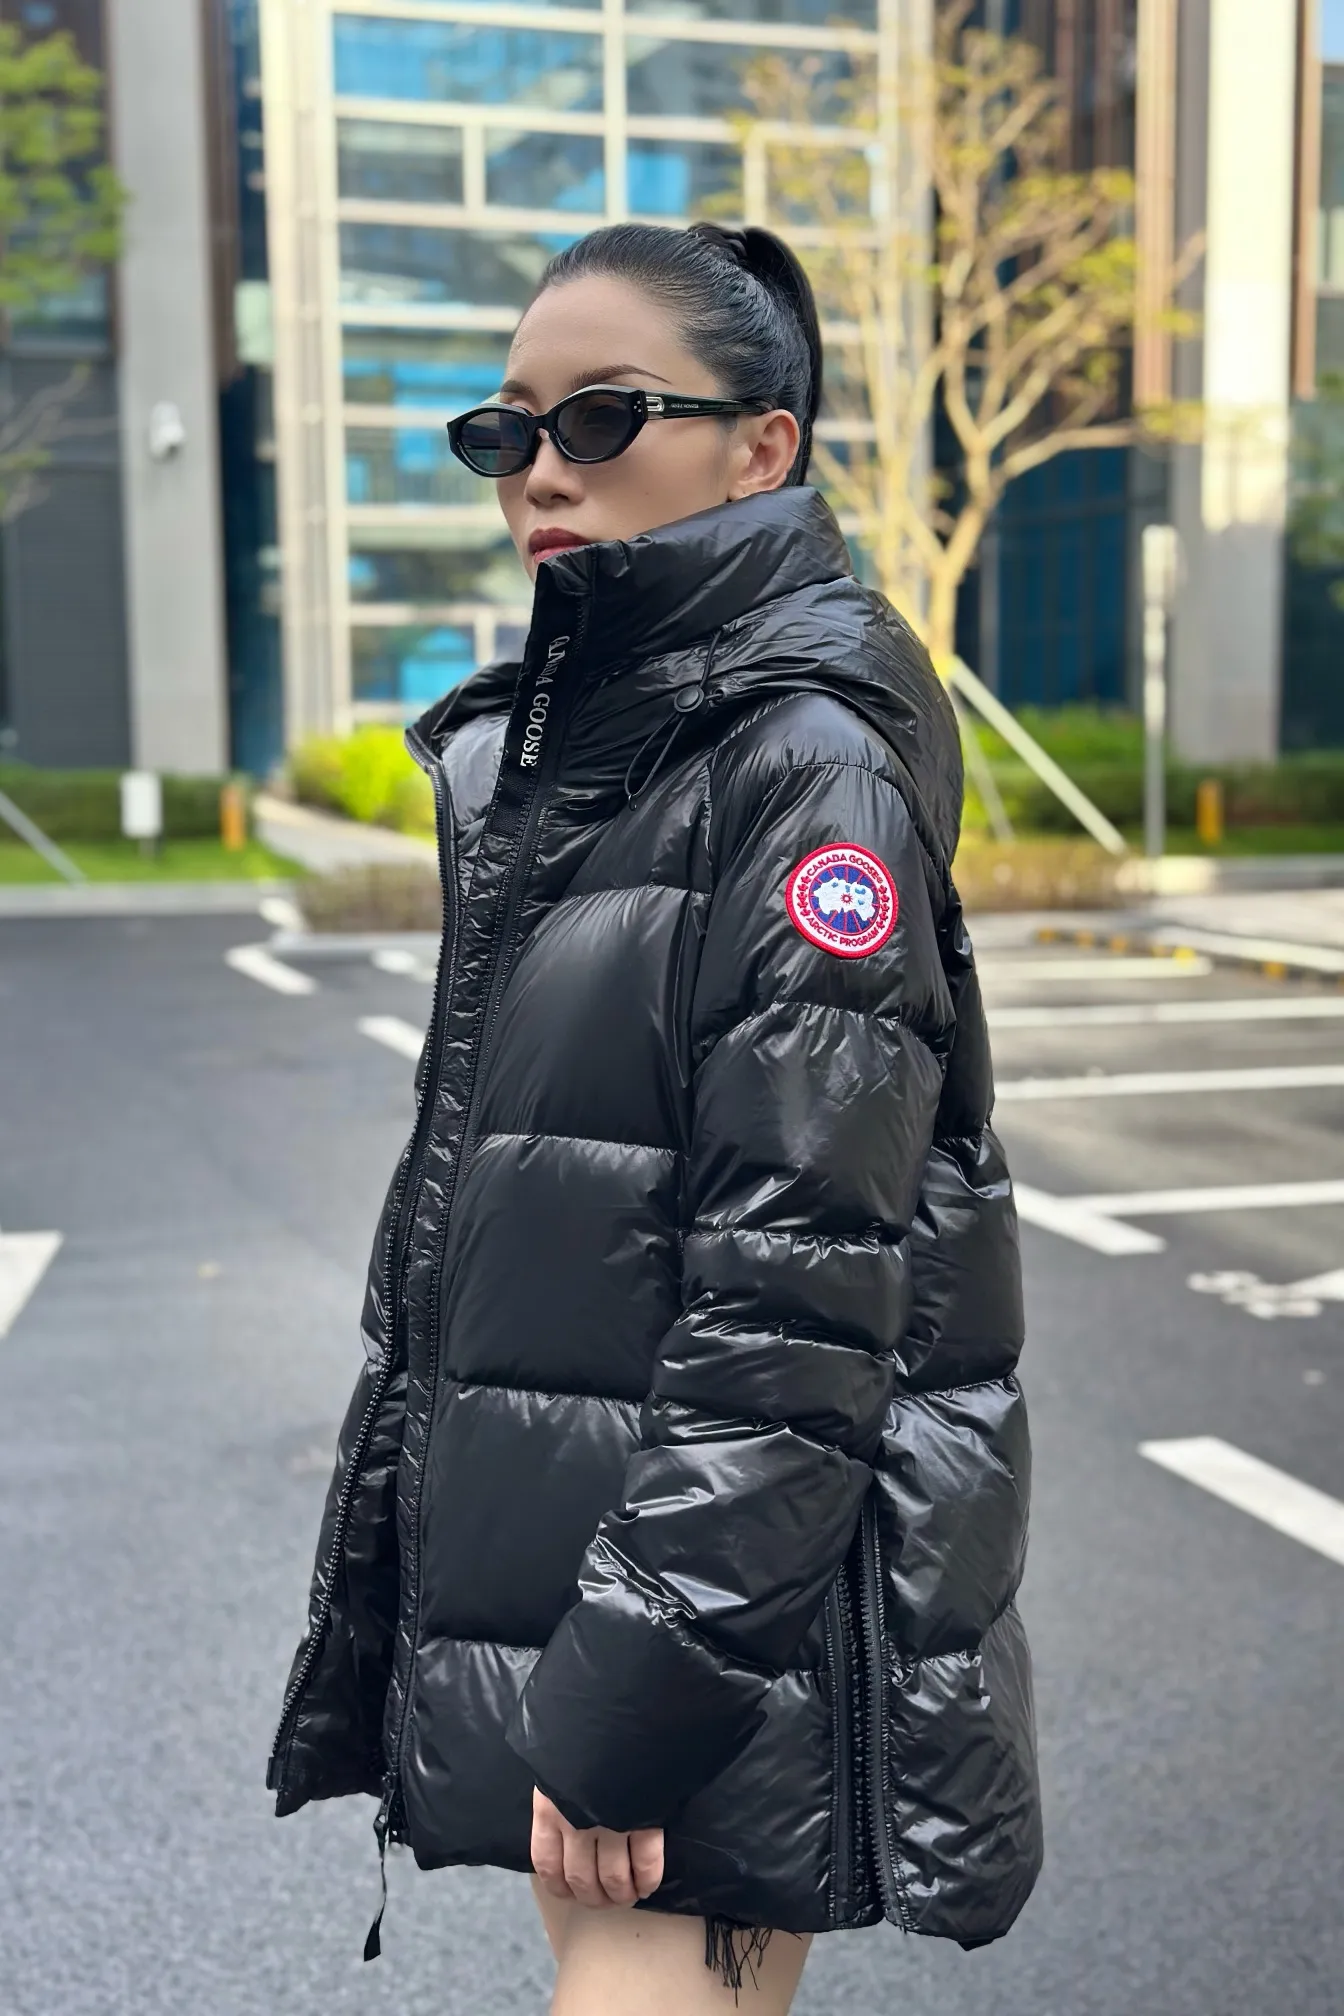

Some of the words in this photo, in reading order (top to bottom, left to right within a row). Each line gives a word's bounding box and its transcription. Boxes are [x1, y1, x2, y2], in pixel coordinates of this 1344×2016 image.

[520, 693, 551, 767] GOOSE
[807, 853, 848, 877] CANADA
[806, 917, 839, 942] ARCTIC
[839, 927, 880, 947] PROGRAM
